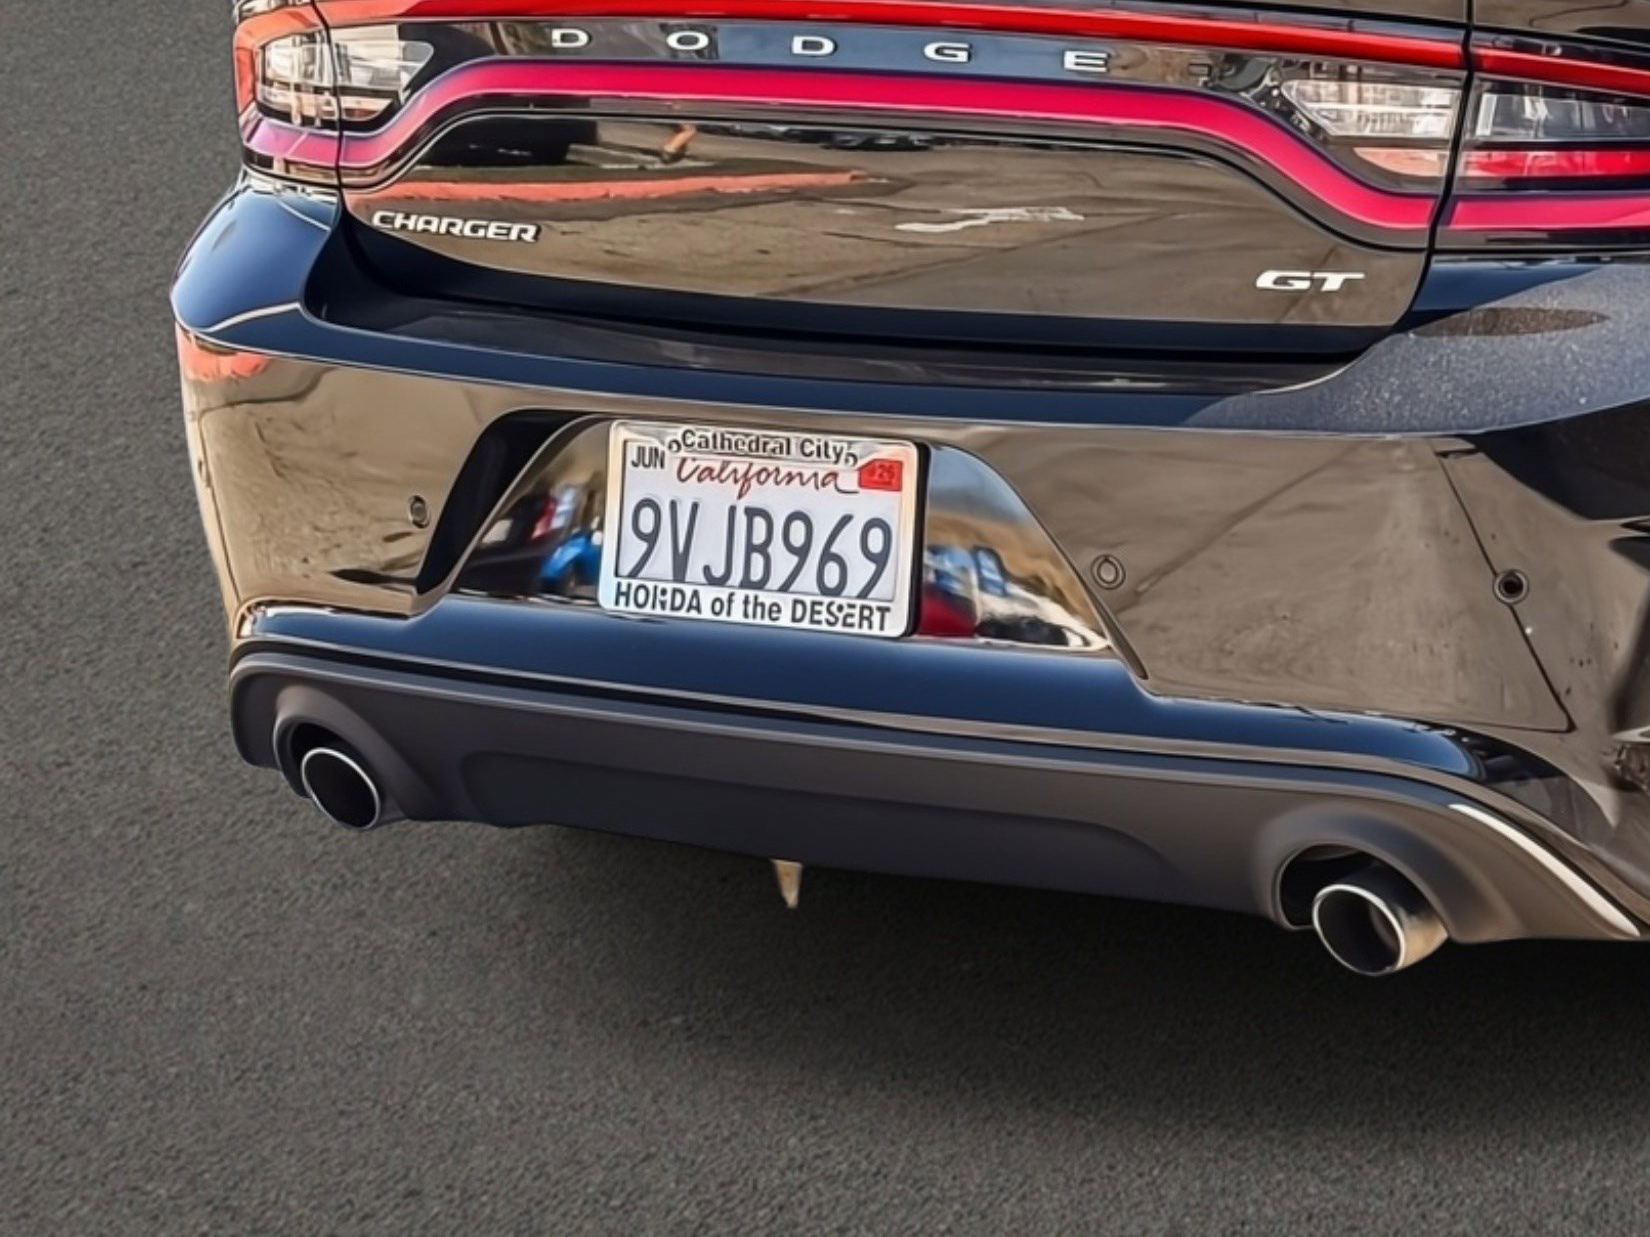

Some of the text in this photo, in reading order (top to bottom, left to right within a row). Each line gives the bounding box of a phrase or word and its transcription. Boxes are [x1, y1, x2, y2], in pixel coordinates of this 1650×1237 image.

[550, 26, 1110, 73] DODGE
[371, 210, 540, 243] CHARGER
[1255, 269, 1366, 292] GT
[630, 445, 667, 470] JUN
[681, 428, 845, 465] Cathedral City
[676, 457, 860, 500] California
[629, 497, 894, 599] 9VJB969
[614, 581, 892, 632] HONDA of the DESERT
